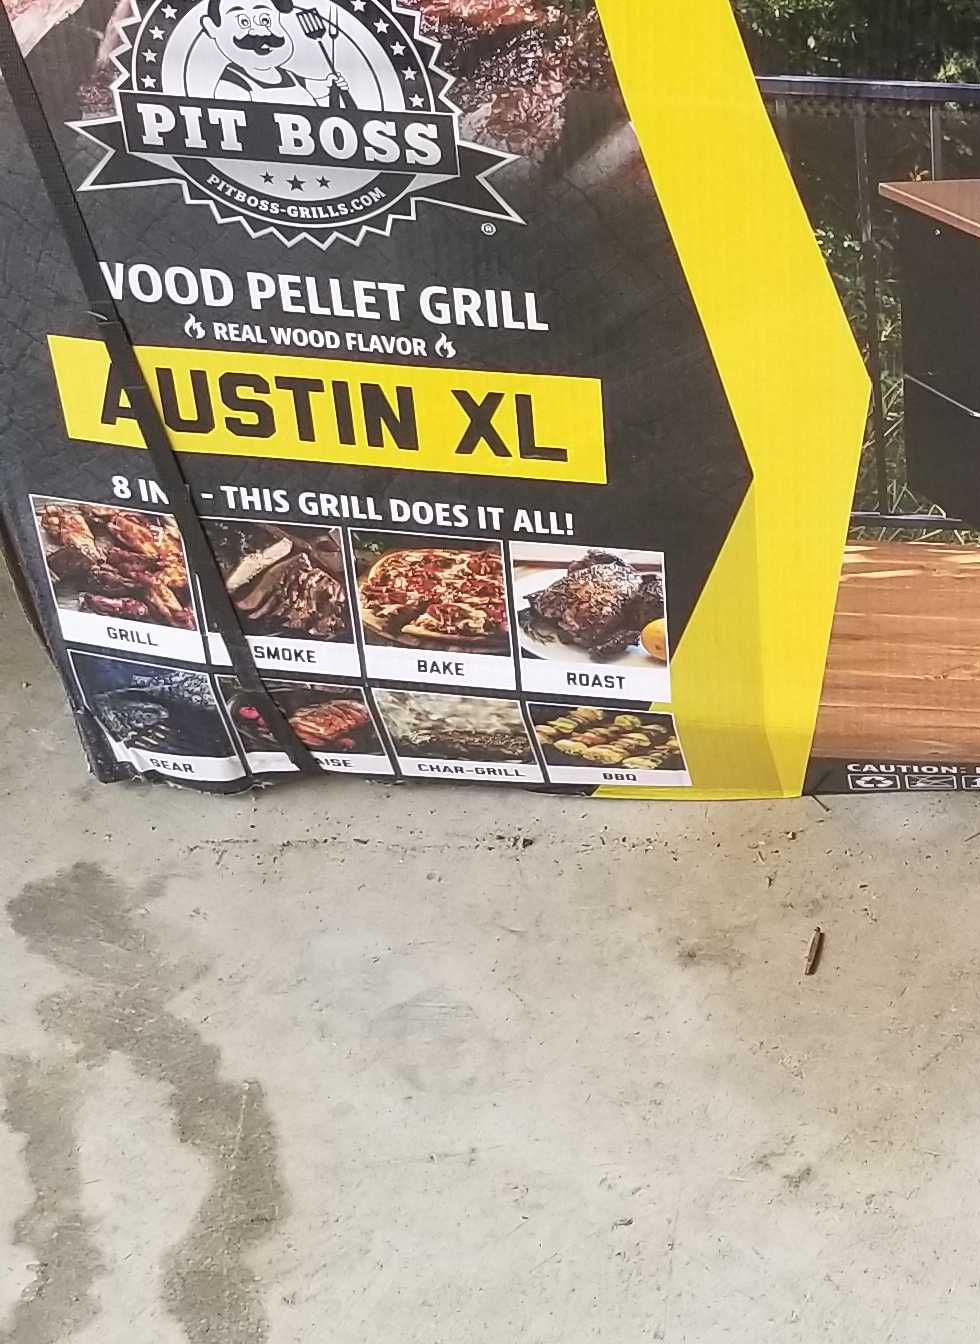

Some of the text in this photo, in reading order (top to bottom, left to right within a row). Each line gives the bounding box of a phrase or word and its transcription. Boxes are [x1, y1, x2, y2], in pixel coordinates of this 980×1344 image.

[135, 102, 444, 167] PIT BOSS
[206, 172, 388, 220] PITBOSS-GRILLS.COM
[247, 271, 408, 323] PELLET
[418, 284, 550, 331] GRILL
[212, 321, 428, 357] REAL WOOD FLAVOR
[99, 360, 569, 463] AUSTIN XL
[111, 474, 132, 500] 8
[219, 484, 291, 514] THIS
[297, 492, 383, 522] GRILL
[388, 498, 469, 530] DOES
[477, 506, 504, 532] IT
[512, 509, 574, 538] ALL!
[106, 626, 159, 647] GRILL
[253, 645, 317, 665] SMOKE
[417, 659, 466, 678] BAKE
[565, 671, 627, 692] ROAST
[416, 762, 526, 778] CHAR-GRILL
[602, 771, 639, 782] BBQ
[846, 762, 969, 774] CAUTION:
